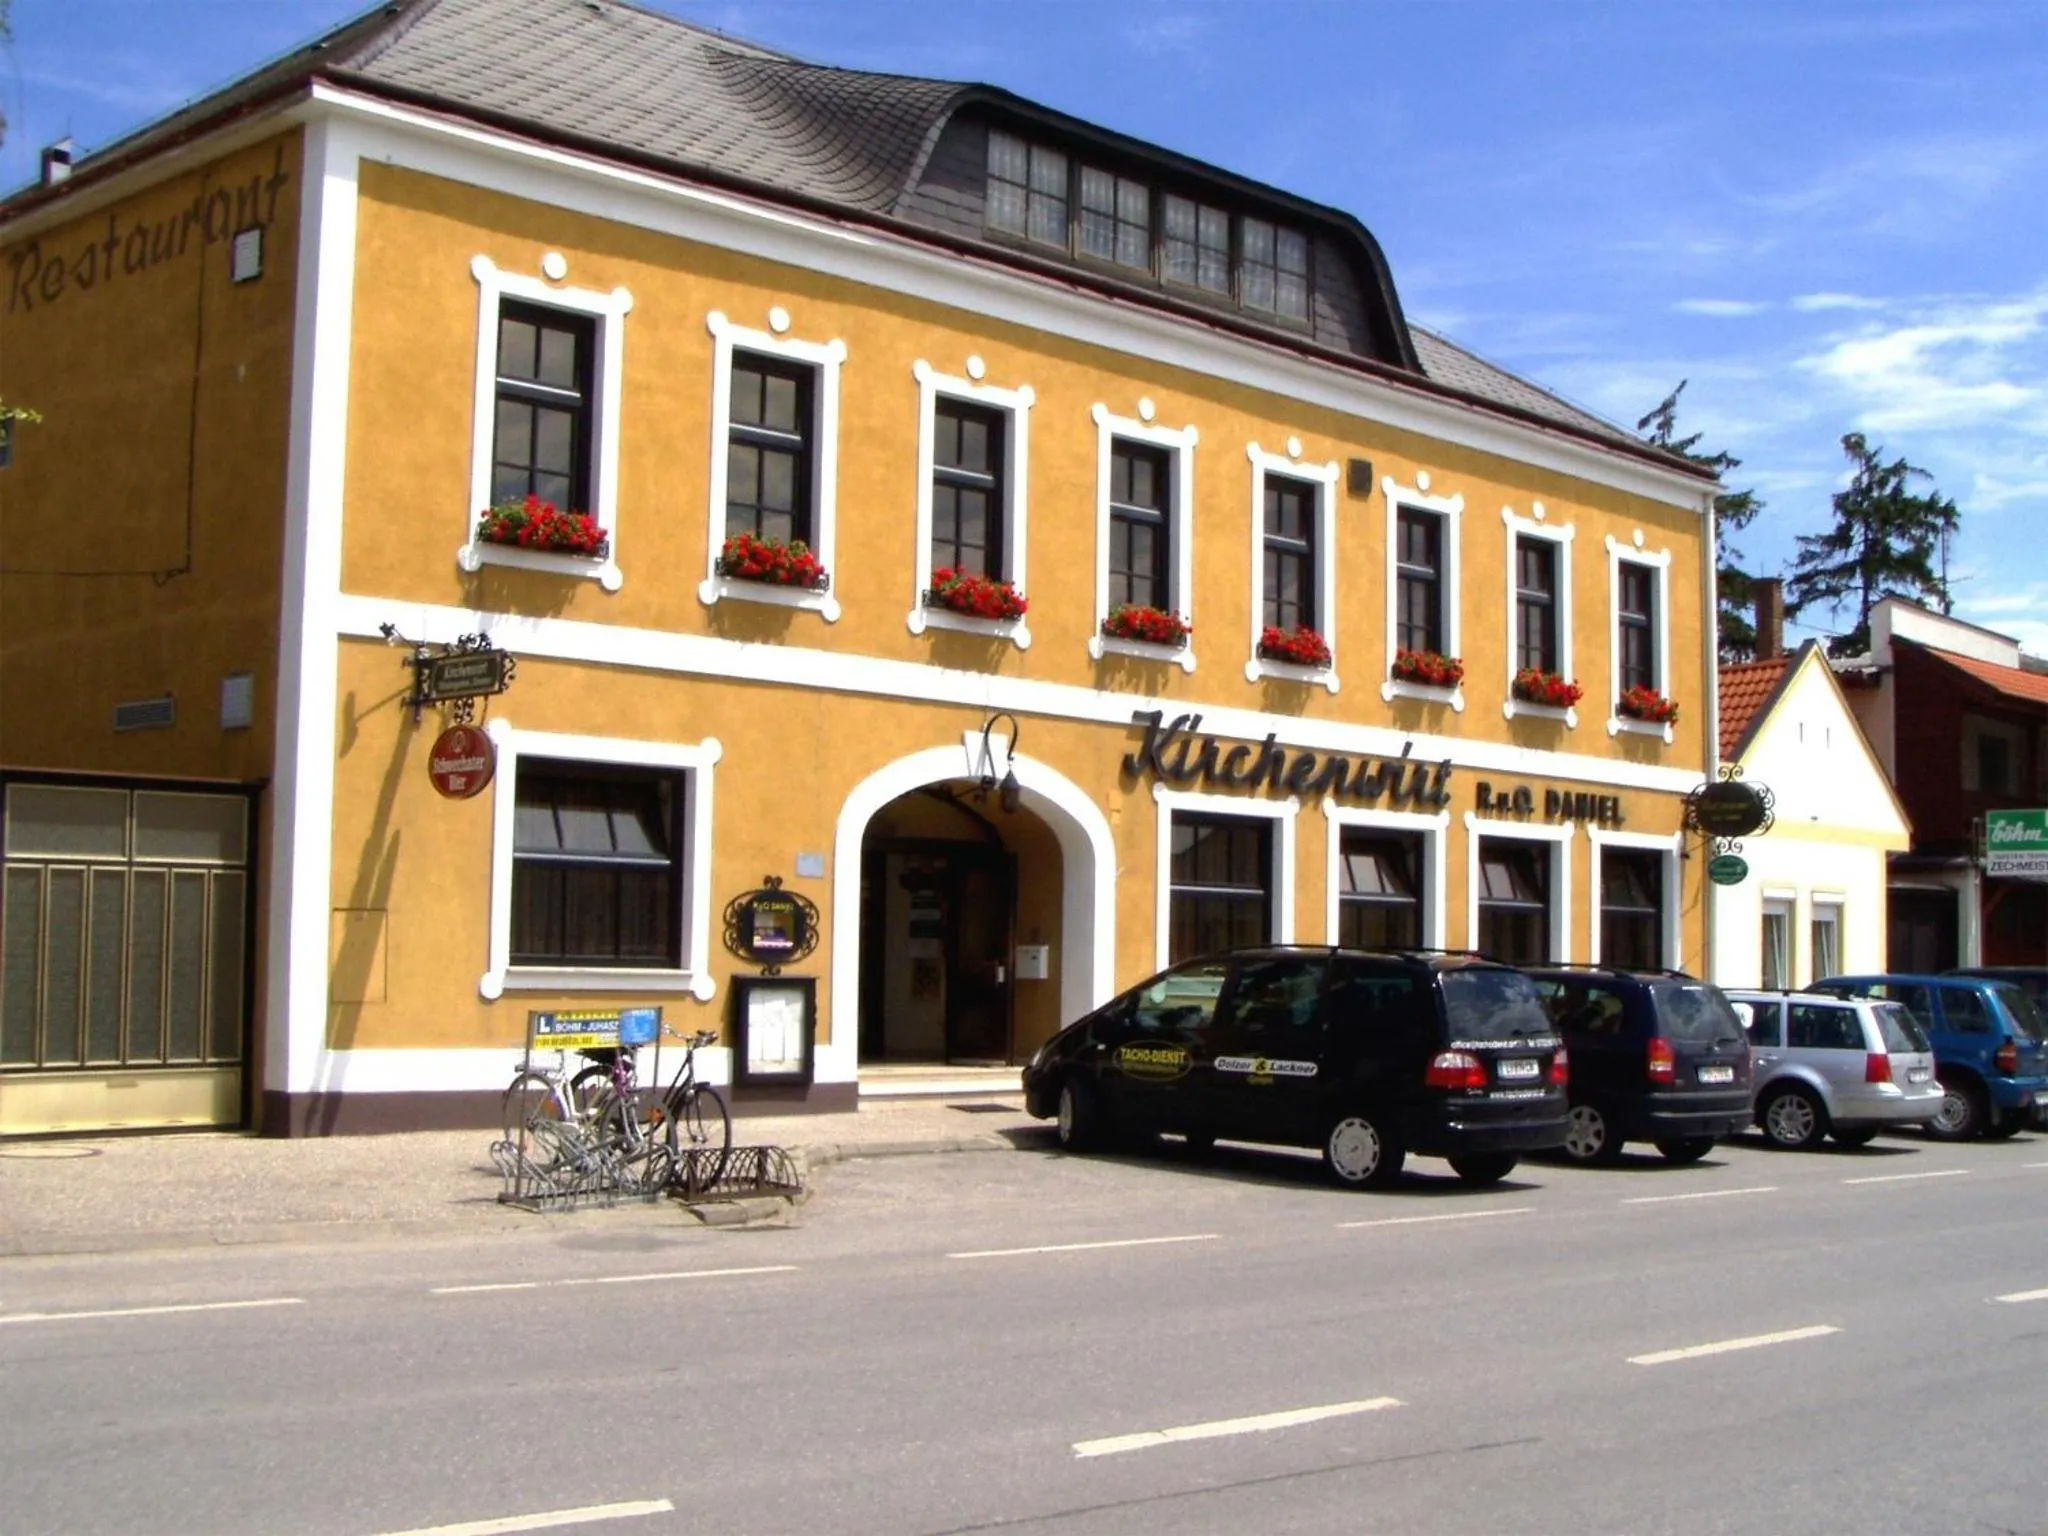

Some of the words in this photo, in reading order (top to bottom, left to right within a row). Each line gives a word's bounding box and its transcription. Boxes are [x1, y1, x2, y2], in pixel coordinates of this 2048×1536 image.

[8, 143, 290, 314] Restaurant
[1123, 709, 1452, 807] Kirchenwirt
[1545, 788, 1625, 824] DANIEL
[1256, 1060, 1266, 1071] &
